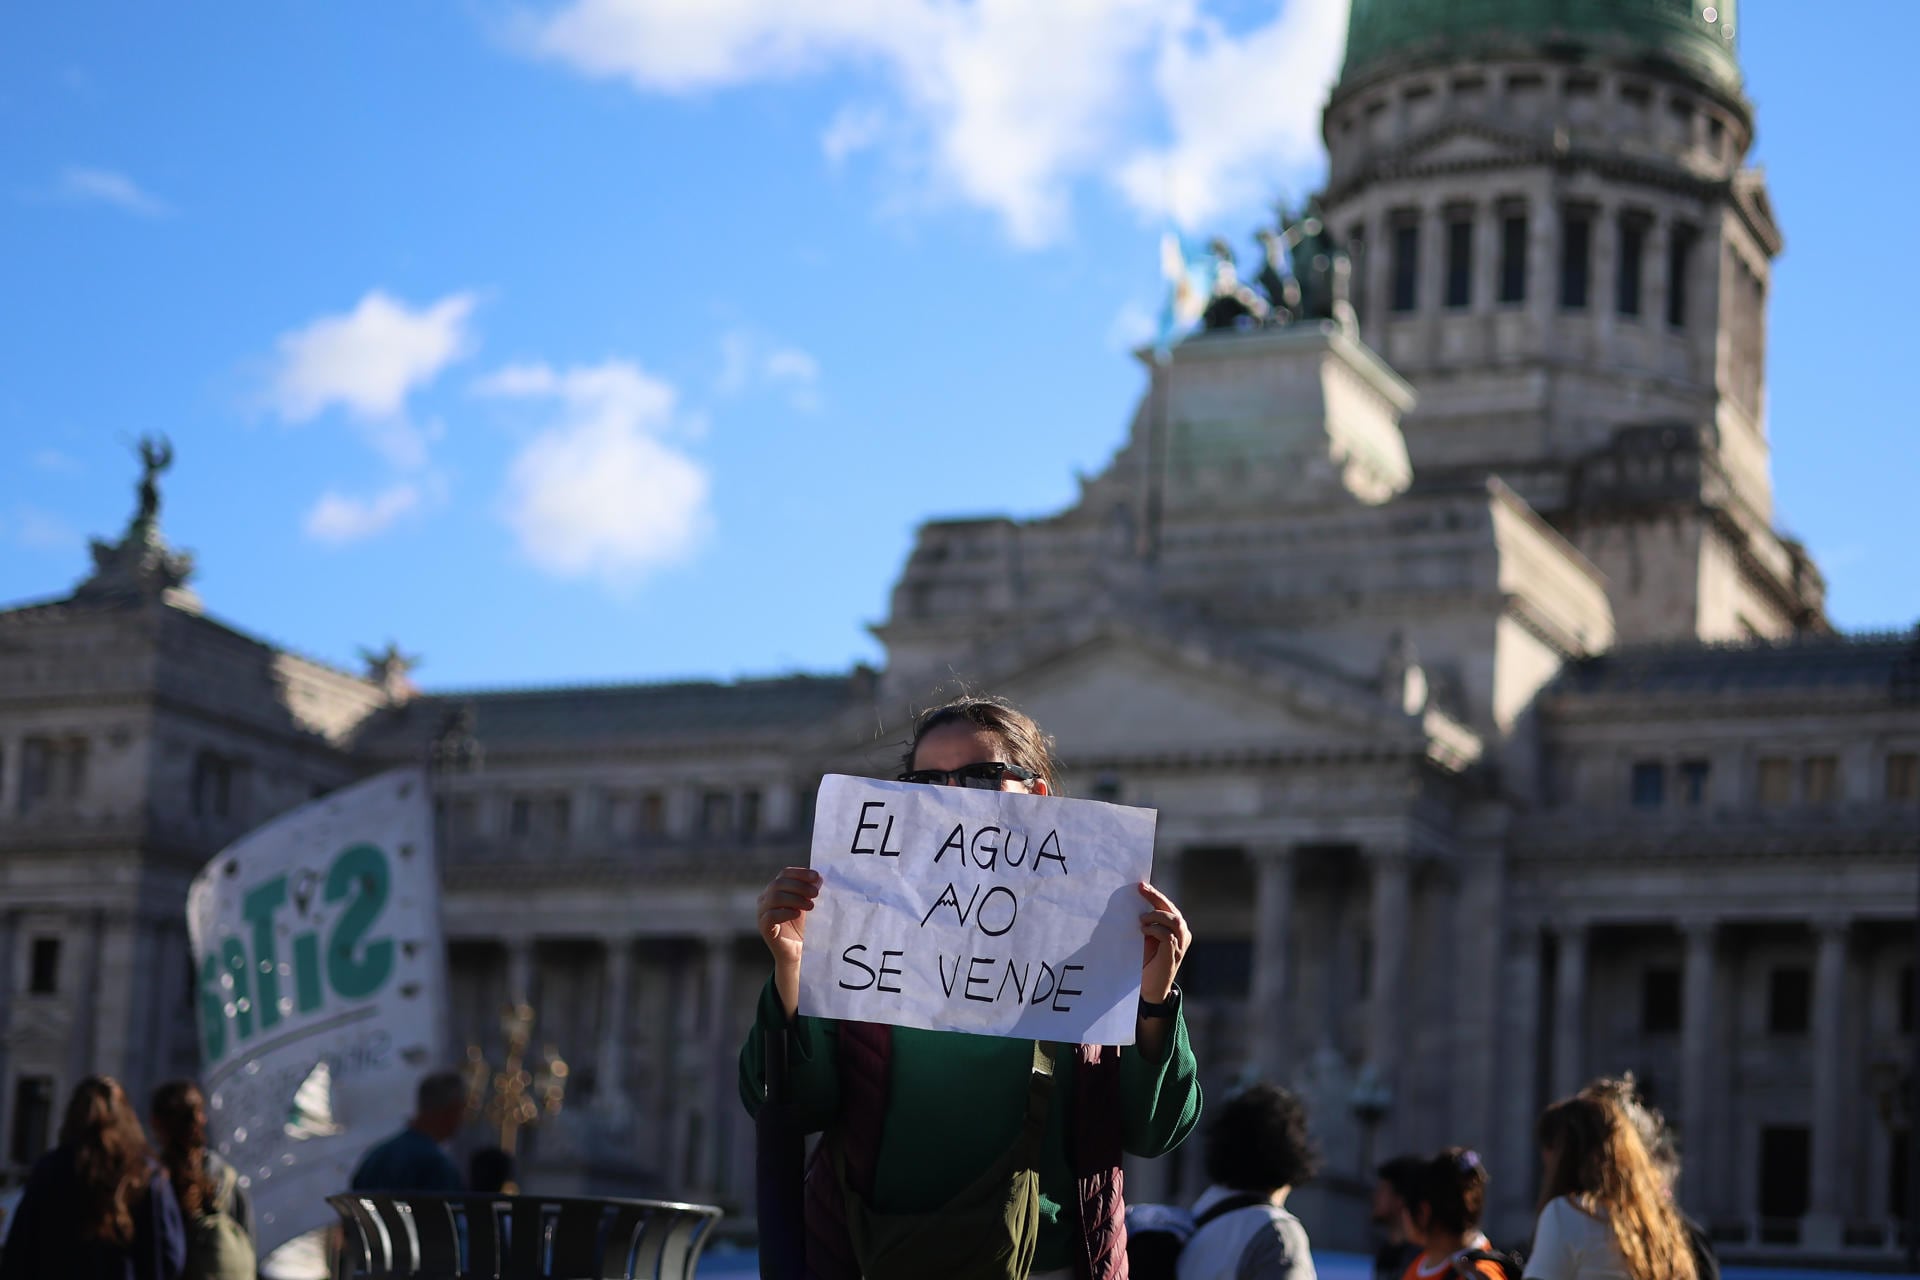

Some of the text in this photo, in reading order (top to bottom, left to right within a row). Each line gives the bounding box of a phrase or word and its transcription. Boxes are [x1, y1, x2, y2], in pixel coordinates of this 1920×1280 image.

[850, 801, 1068, 875] EL AGUA
[921, 882, 1017, 937] NO
[838, 944, 1085, 1012] SE VENDE
